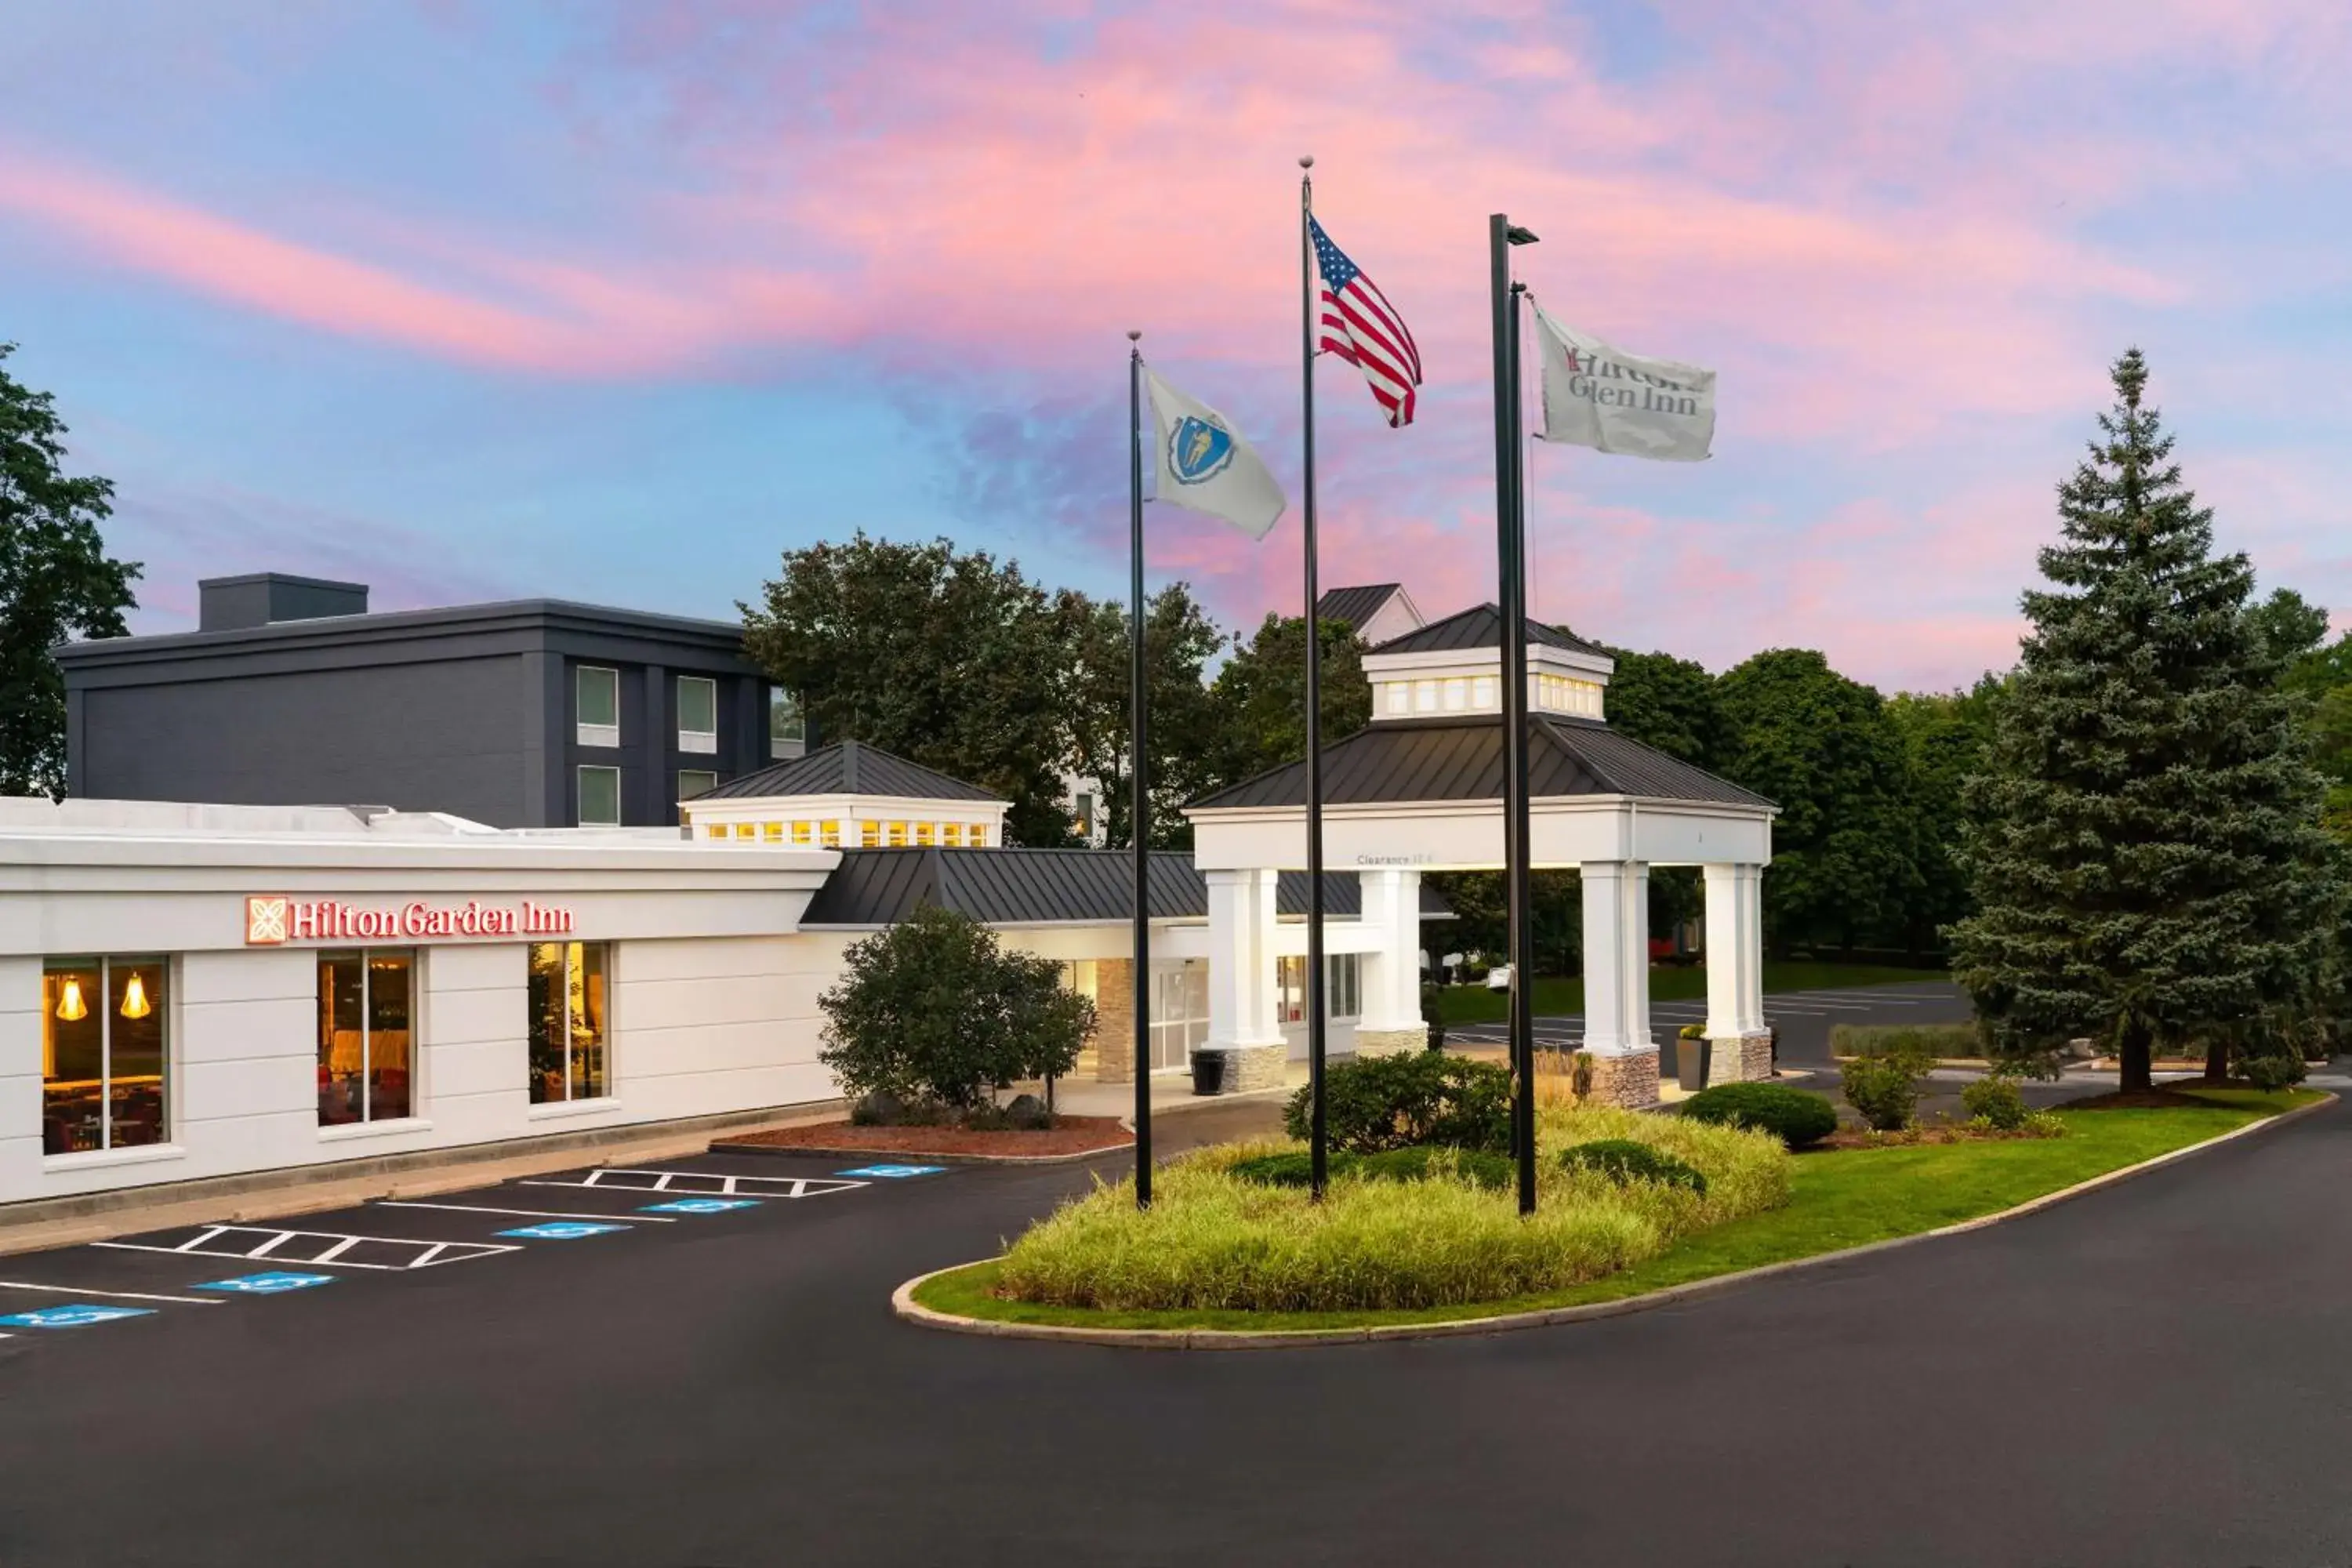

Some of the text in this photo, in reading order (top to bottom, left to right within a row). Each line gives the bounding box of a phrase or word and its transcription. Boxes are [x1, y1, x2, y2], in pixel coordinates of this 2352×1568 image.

[1644, 387, 1697, 416] Inn
[289, 902, 575, 937] Hilton Garden Inn
